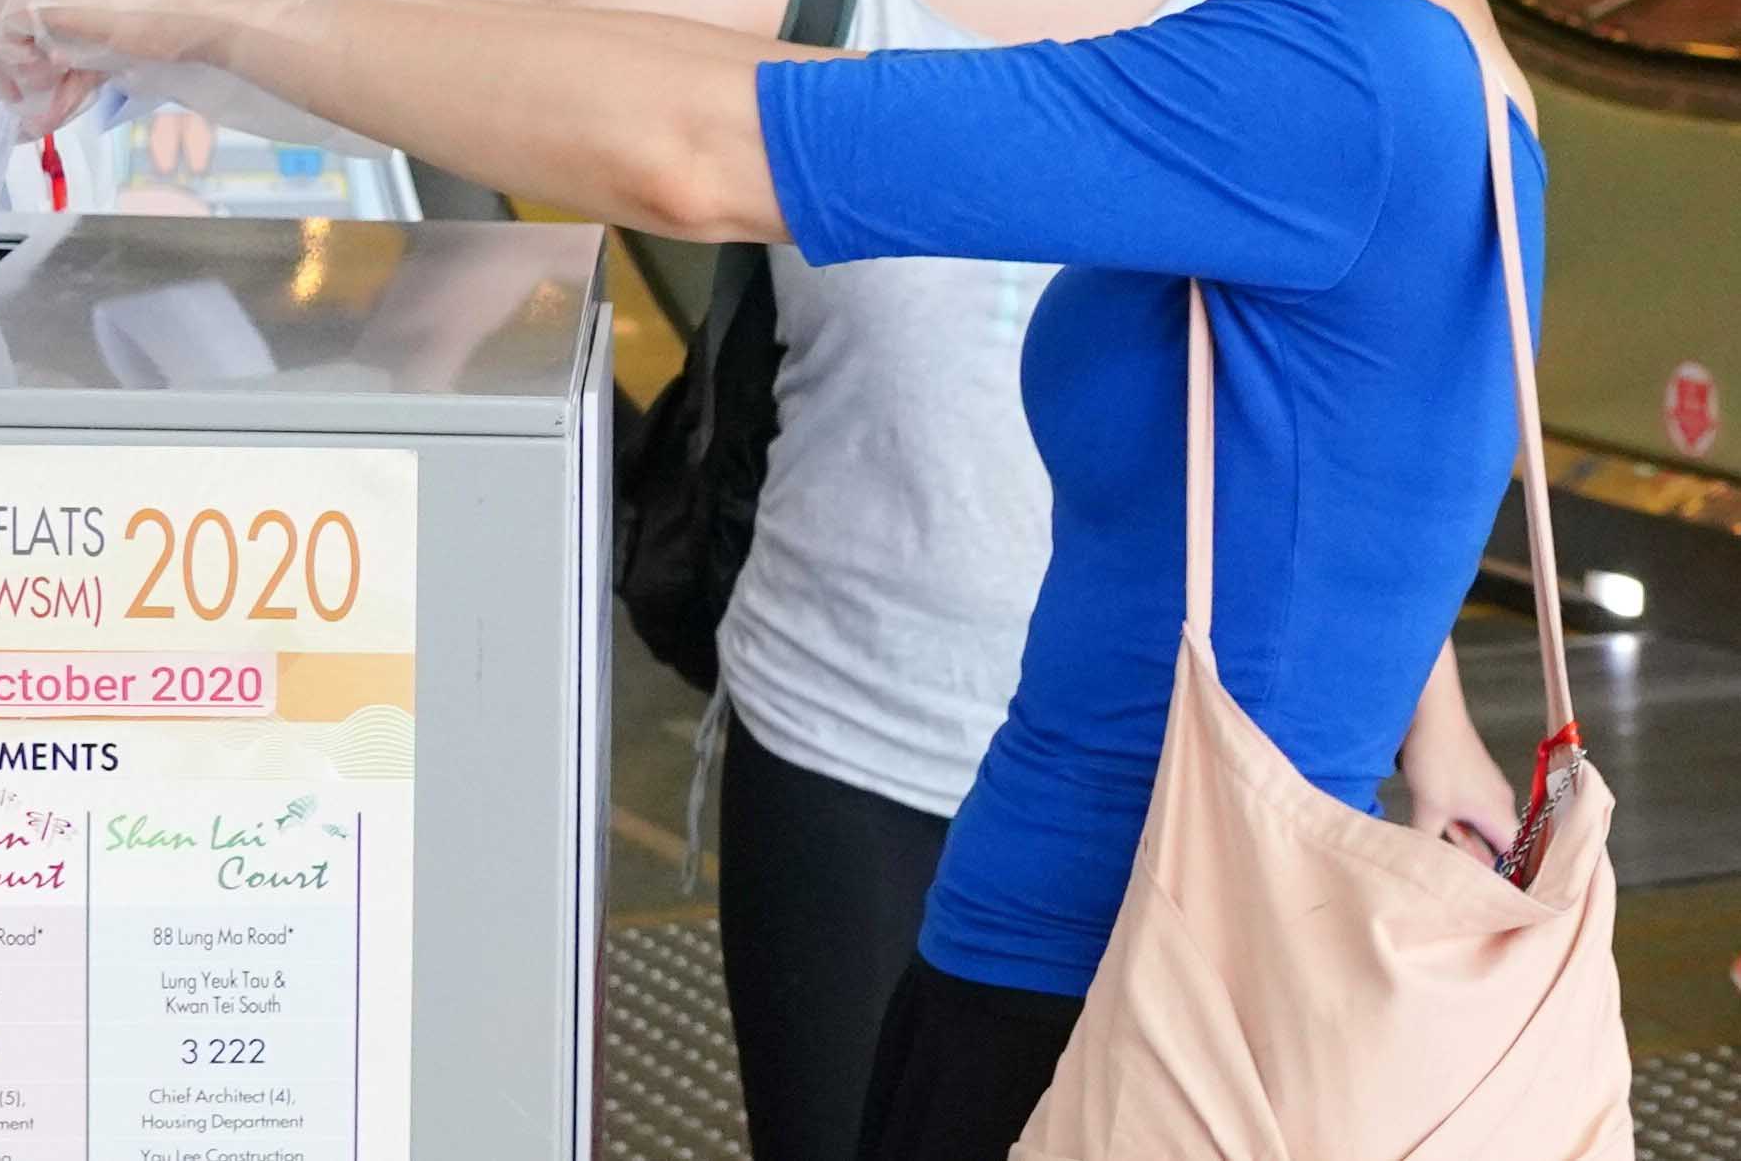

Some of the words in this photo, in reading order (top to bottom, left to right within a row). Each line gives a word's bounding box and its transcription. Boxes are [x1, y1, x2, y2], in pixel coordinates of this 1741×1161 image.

[124, 507, 361, 622] 2020
[150, 665, 264, 705] 2020
[105, 813, 199, 852] Shan
[209, 814, 267, 851] Lai
[217, 855, 329, 891] Court
[153, 926, 174, 946] 88
[177, 927, 214, 952] Lung
[217, 927, 243, 946] Ma
[161, 971, 197, 996] Lung
[200, 969, 238, 990] Yeuk
[241, 970, 270, 989] Tau
[273, 969, 286, 989] &
[165, 995, 210, 1015] Kwan
[212, 995, 235, 1015] Tei
[238, 994, 282, 1015] South
[148, 1087, 192, 1105] Chief
[194, 1086, 266, 1104] Architect
[141, 1114, 208, 1134] Housing
[210, 1113, 305, 1133] Department
